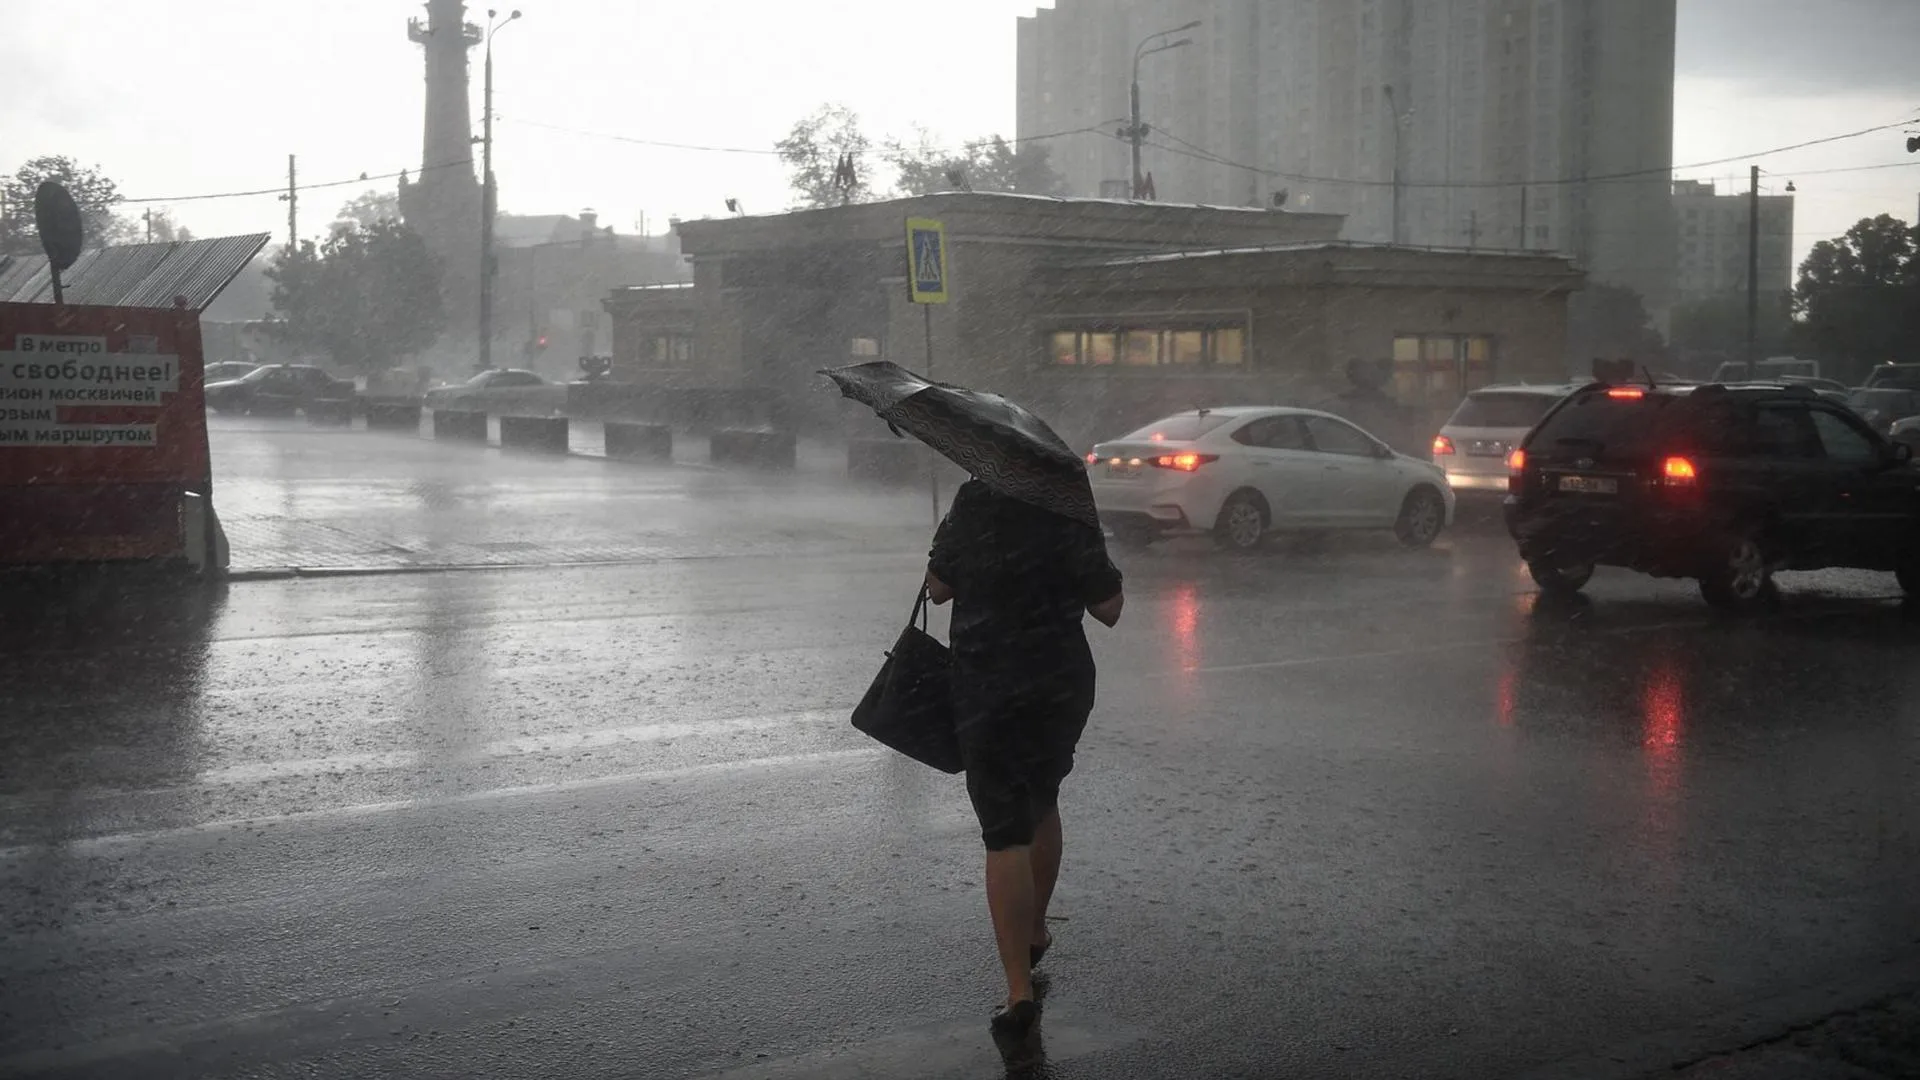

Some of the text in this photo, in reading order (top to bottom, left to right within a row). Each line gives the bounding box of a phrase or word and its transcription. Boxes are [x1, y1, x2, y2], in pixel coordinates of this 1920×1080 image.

[22, 337, 101, 355] В метро
[12, 360, 171, 383] свободнее!
[49, 386, 156, 401] москвичей
[35, 430, 152, 444] маршрутом
